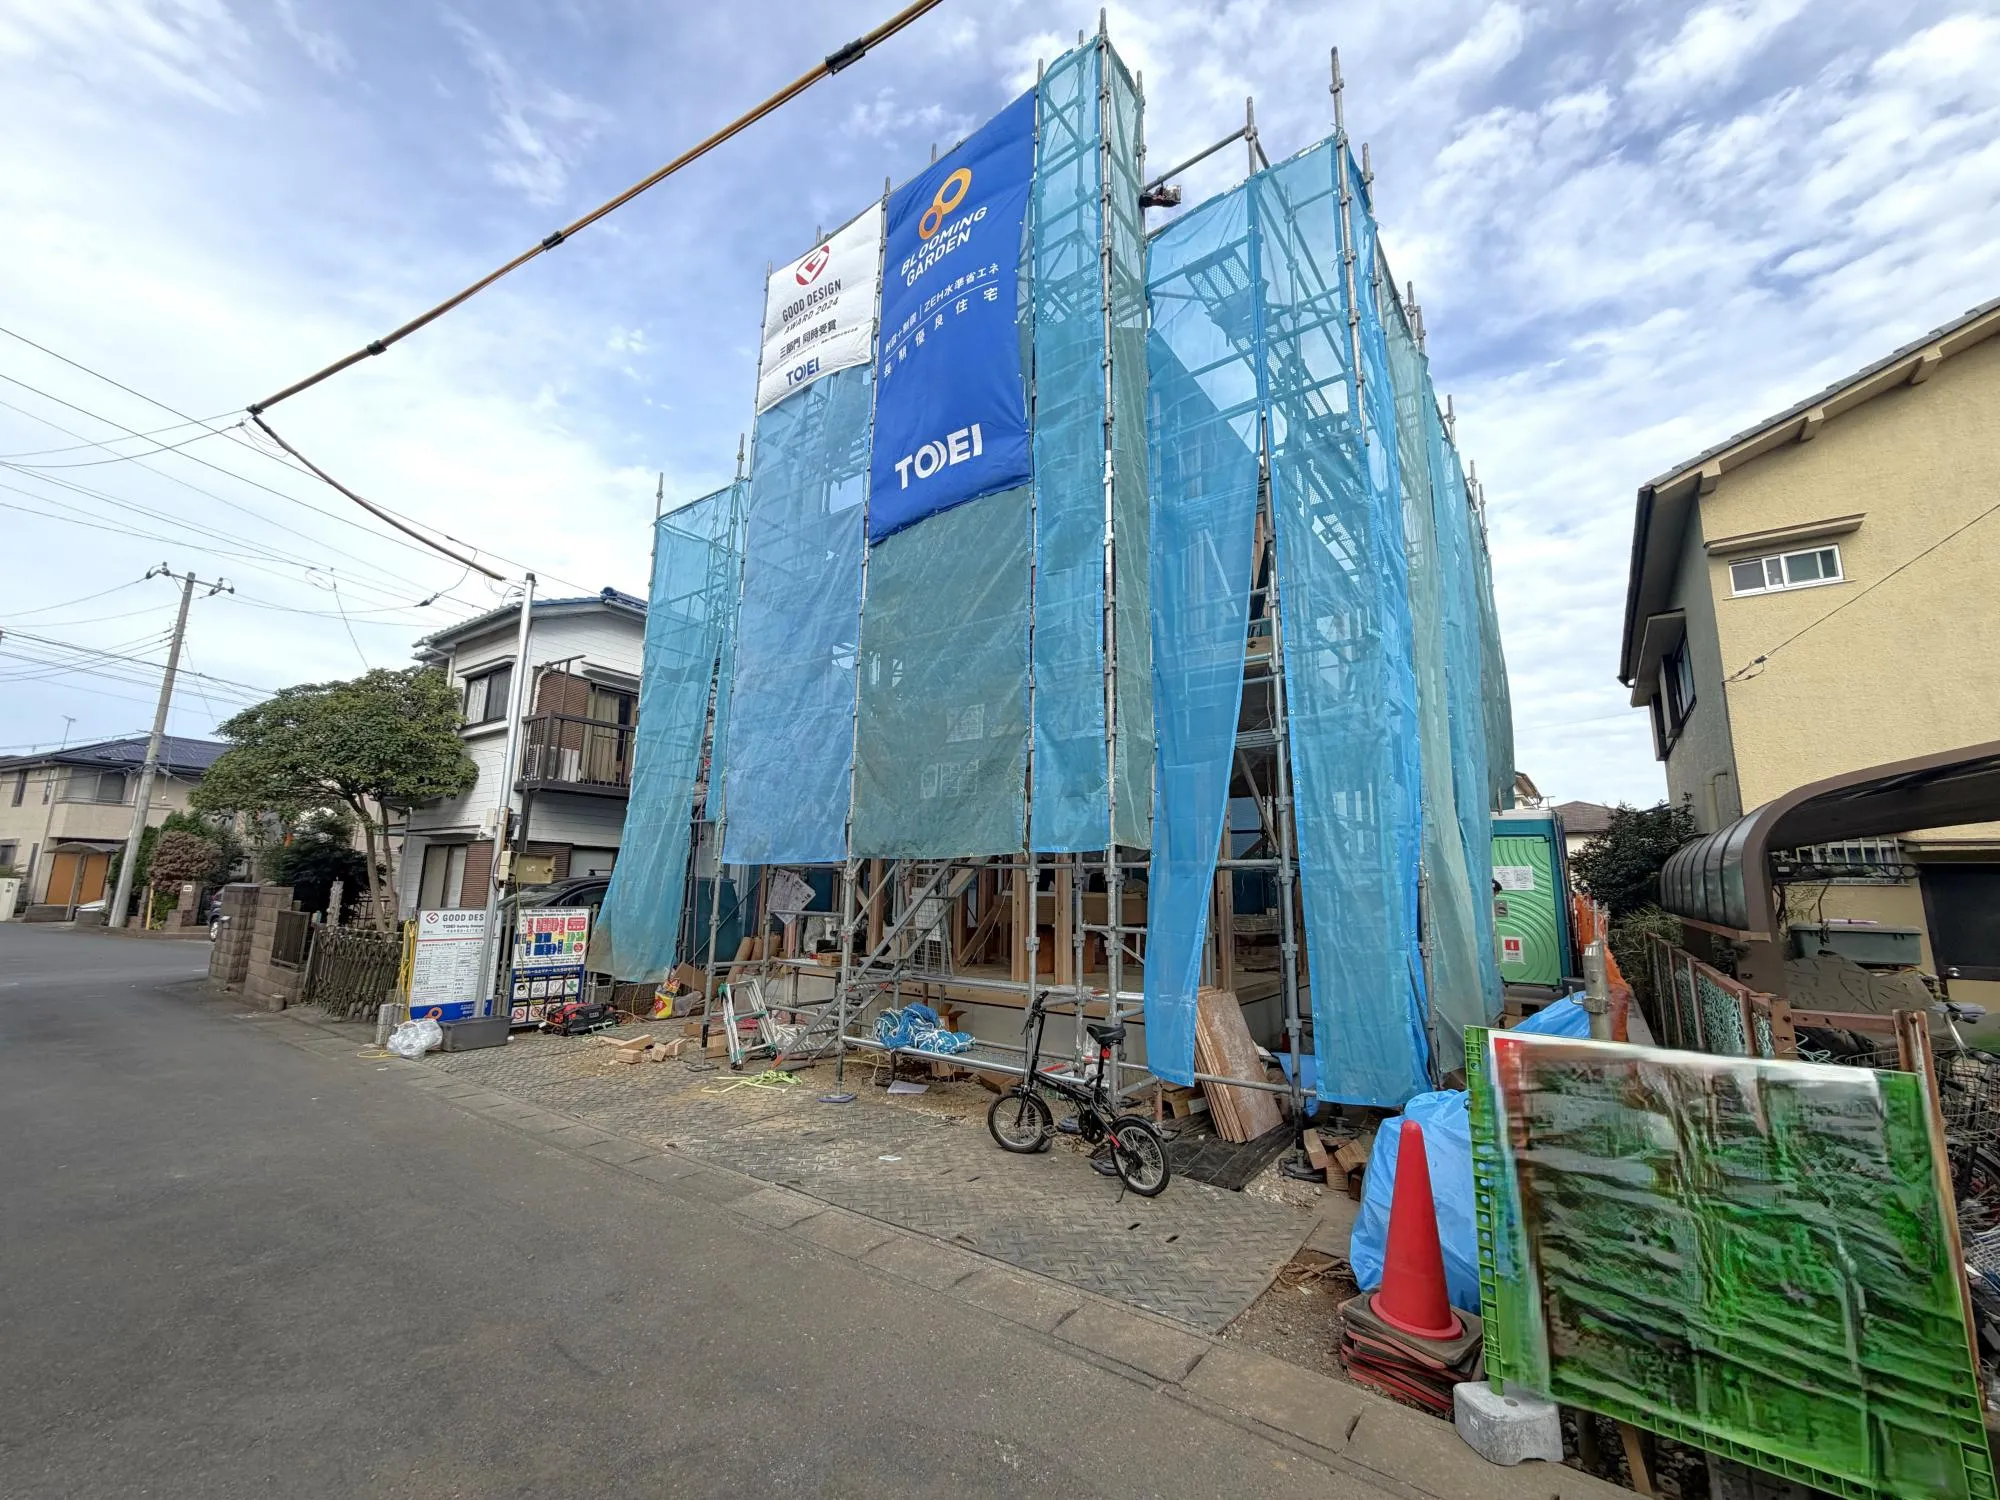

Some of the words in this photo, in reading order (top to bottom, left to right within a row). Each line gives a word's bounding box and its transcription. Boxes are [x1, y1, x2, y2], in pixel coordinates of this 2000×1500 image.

[901, 206, 987, 276] BLOOMING
[906, 227, 971, 287] GARDEN
[782, 299, 805, 322] GOOD
[807, 278, 842, 307] DESIGN
[784, 311, 814, 335] AWARD
[815, 296, 839, 316] 2024
[442, 914, 466, 922] GOOD
